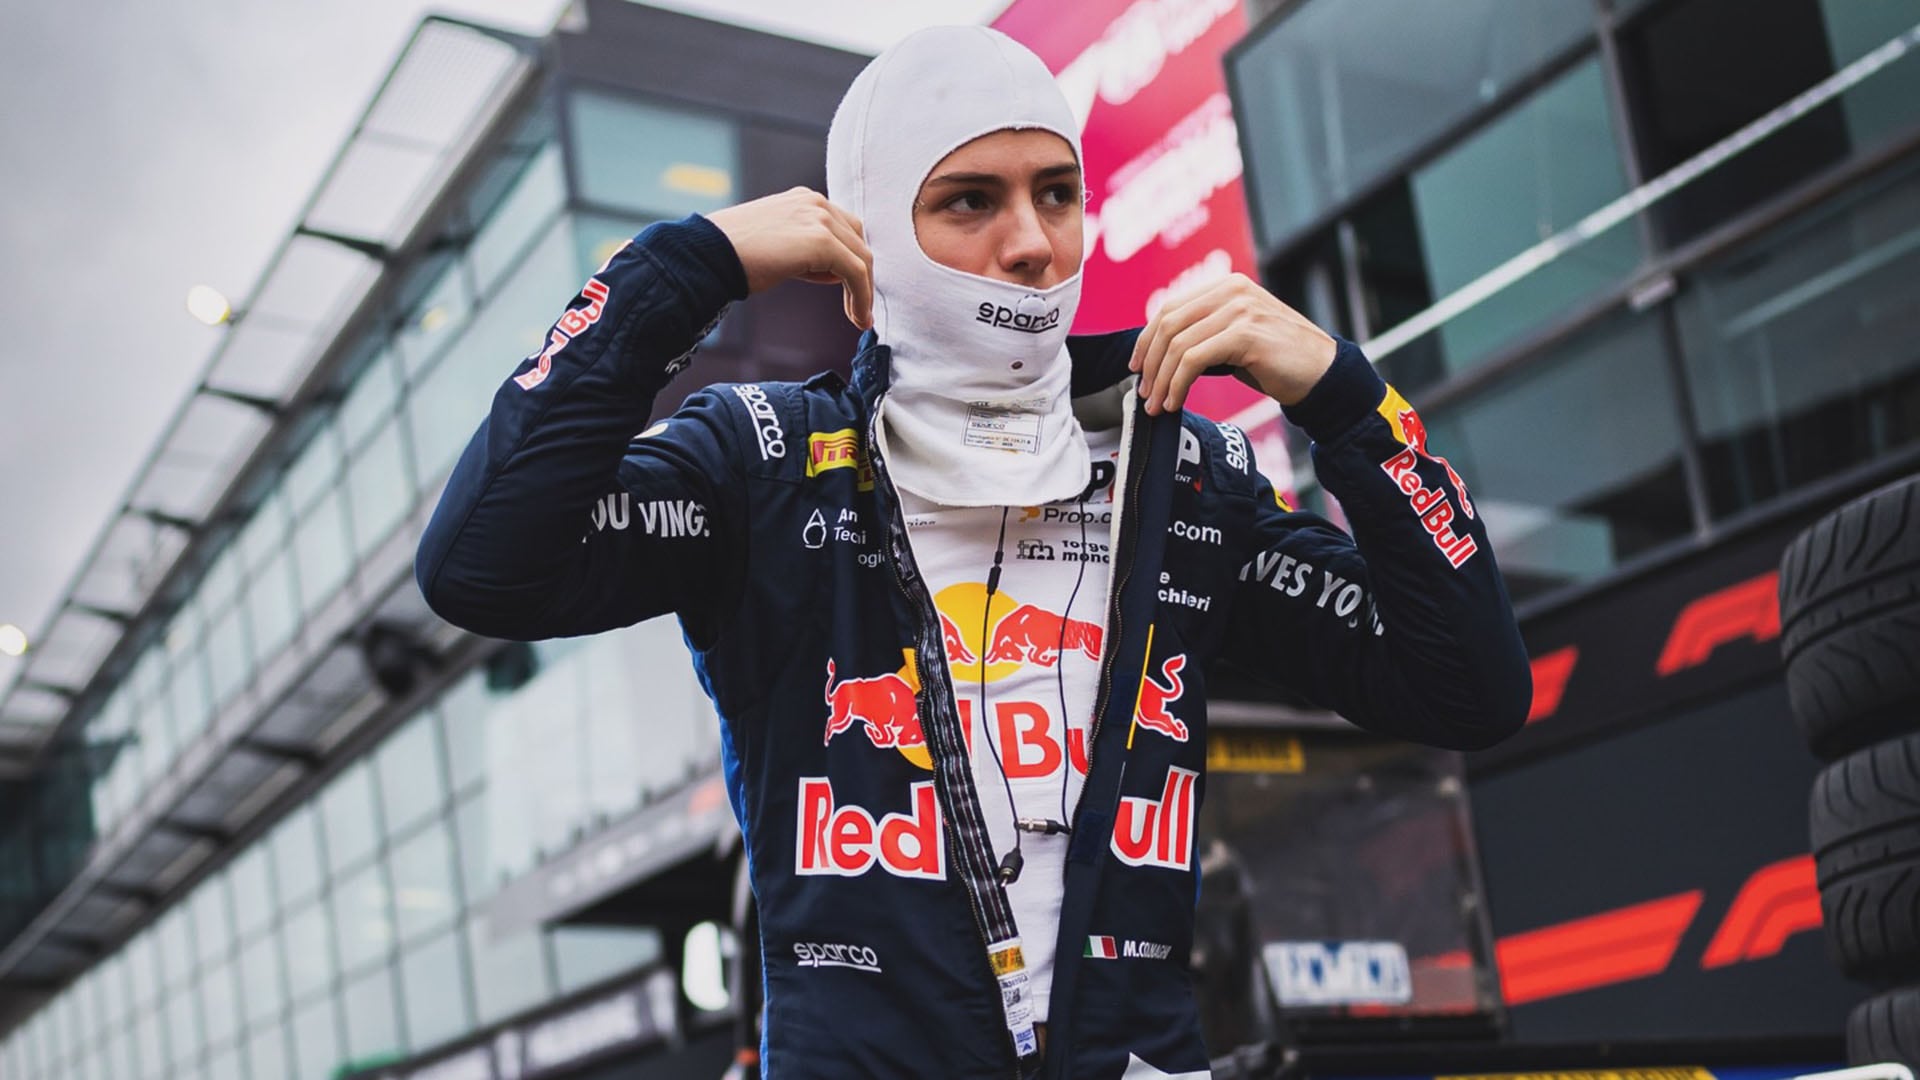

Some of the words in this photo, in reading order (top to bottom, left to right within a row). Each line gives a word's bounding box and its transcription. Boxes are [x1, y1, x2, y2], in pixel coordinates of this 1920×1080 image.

[976, 302, 1060, 333] sparco
[731, 384, 786, 460] sparco
[1380, 446, 1446, 516] Red
[1421, 498, 1478, 570] Bull
[797, 778, 946, 880] Red
[793, 942, 882, 973] sparco
